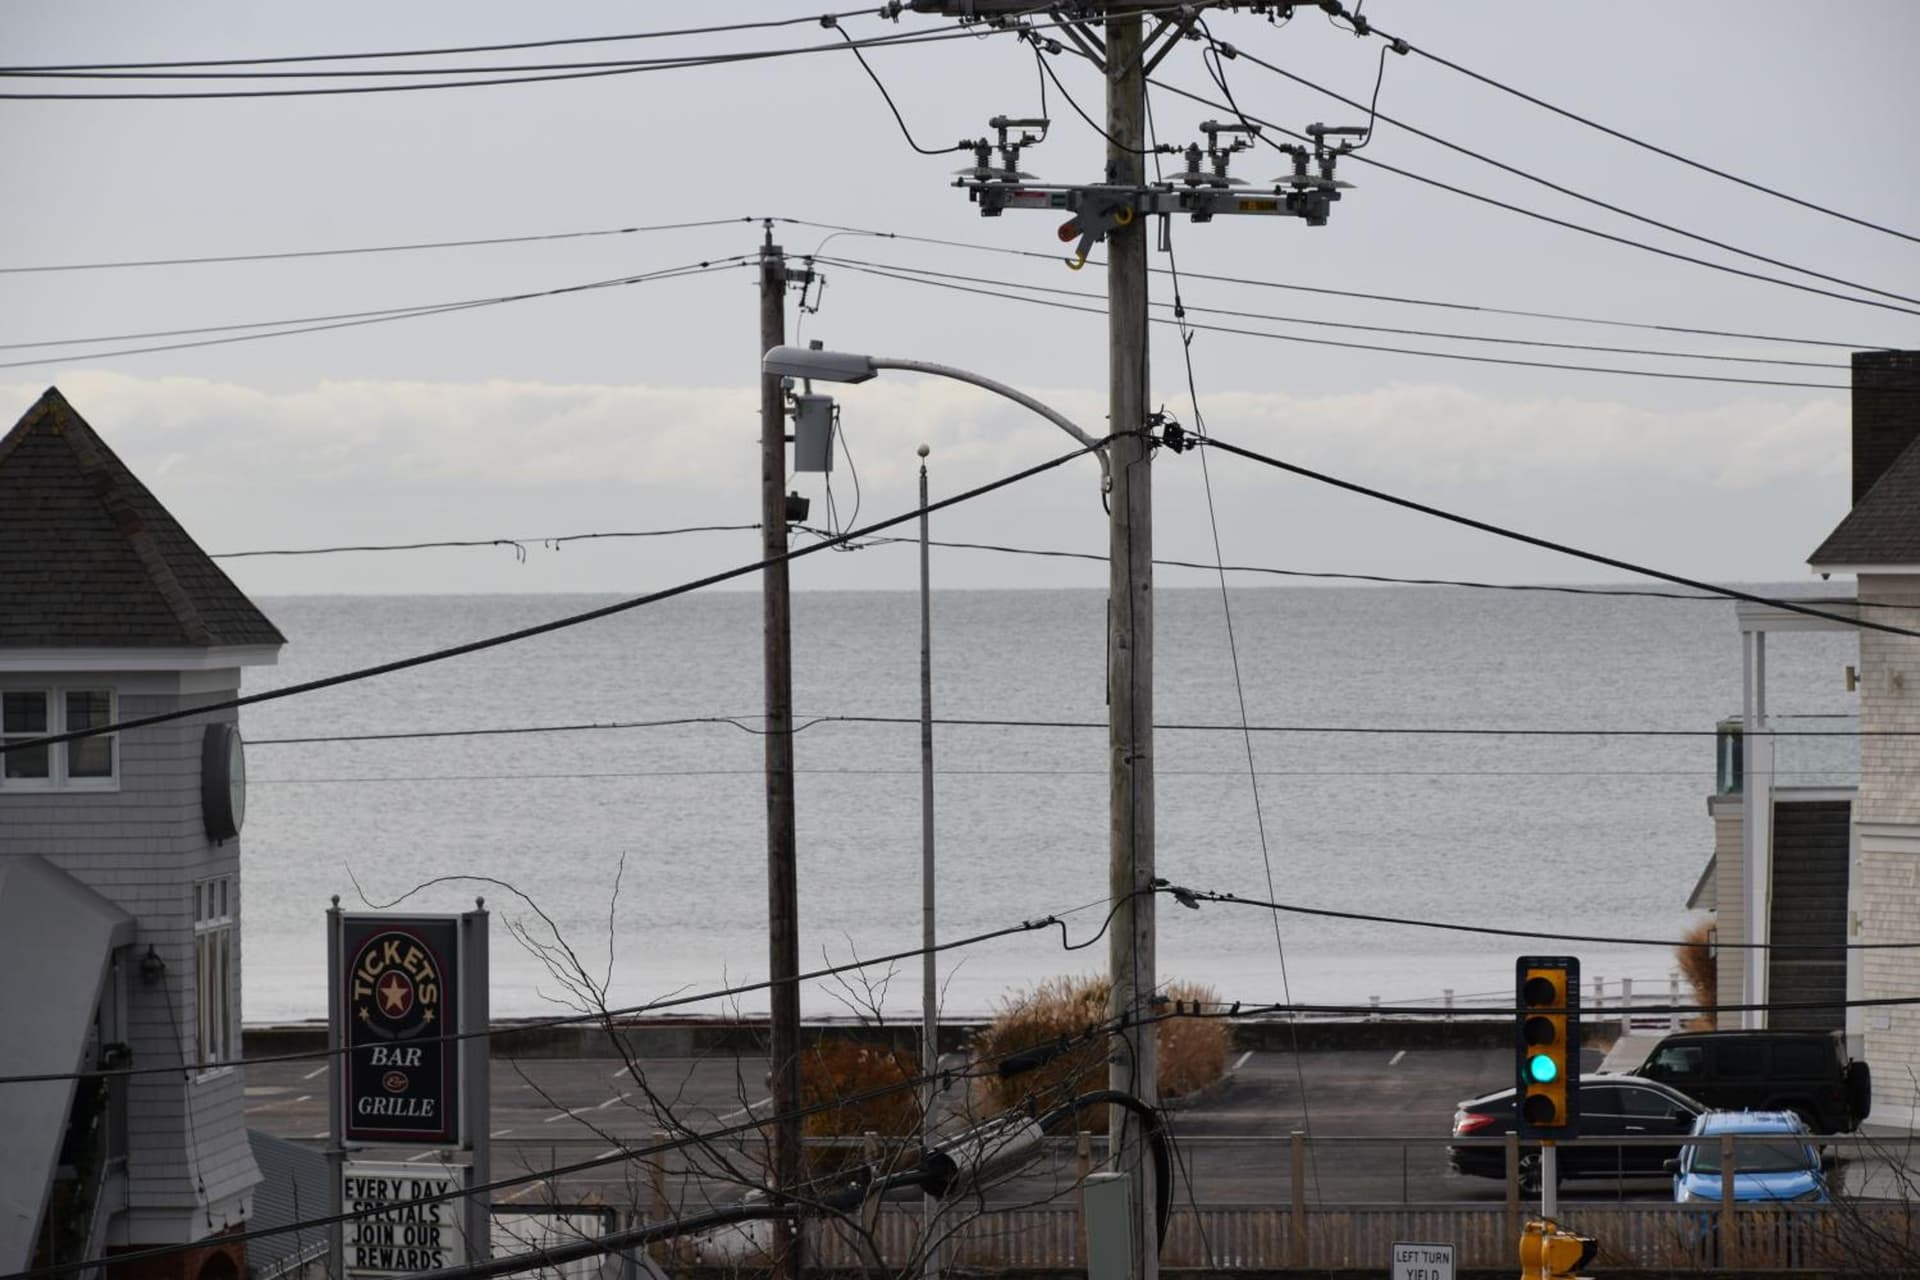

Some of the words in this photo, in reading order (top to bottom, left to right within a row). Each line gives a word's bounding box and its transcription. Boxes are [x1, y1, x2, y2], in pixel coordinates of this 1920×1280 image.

[354, 940, 437, 1005] TICKETS
[370, 1047, 421, 1066] BAR
[358, 1097, 434, 1117] GRILLE
[345, 1178, 402, 1199] EVERY
[411, 1181, 448, 1199] DAY
[352, 1201, 440, 1224] SPECIALS
[352, 1225, 394, 1245] JOIN
[404, 1226, 440, 1247] OUR
[356, 1248, 442, 1270] REWARDS
[1396, 1251, 1419, 1263] LEFT
[1422, 1251, 1449, 1264] TURN
